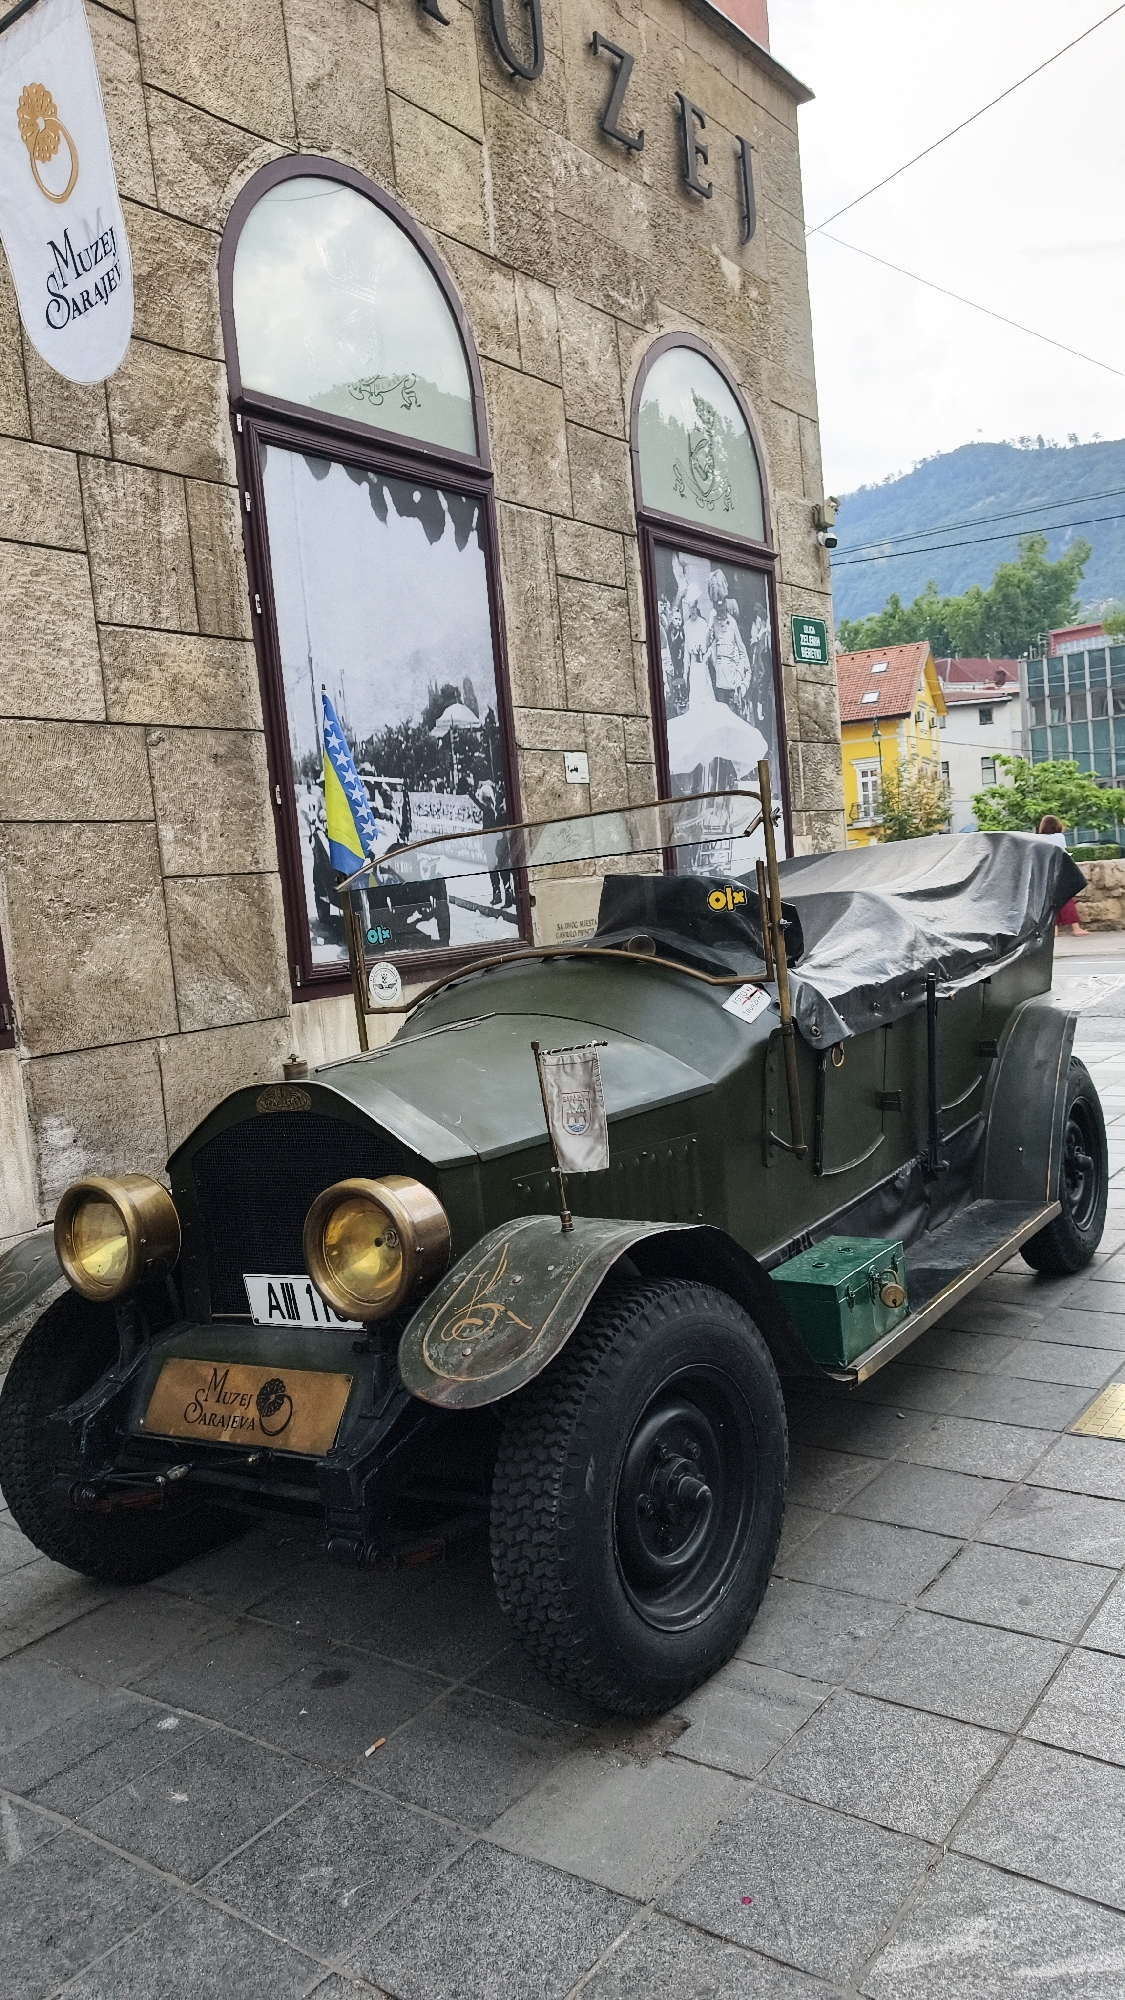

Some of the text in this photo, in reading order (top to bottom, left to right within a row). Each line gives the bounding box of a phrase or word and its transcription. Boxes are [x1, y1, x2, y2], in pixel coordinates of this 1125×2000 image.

[417, 0, 757, 245] UZEJ
[47, 227, 117, 290] MUZEJ
[184, 1388, 256, 1432] SARAJEVA
[203, 1367, 254, 1411] MUZEJ
